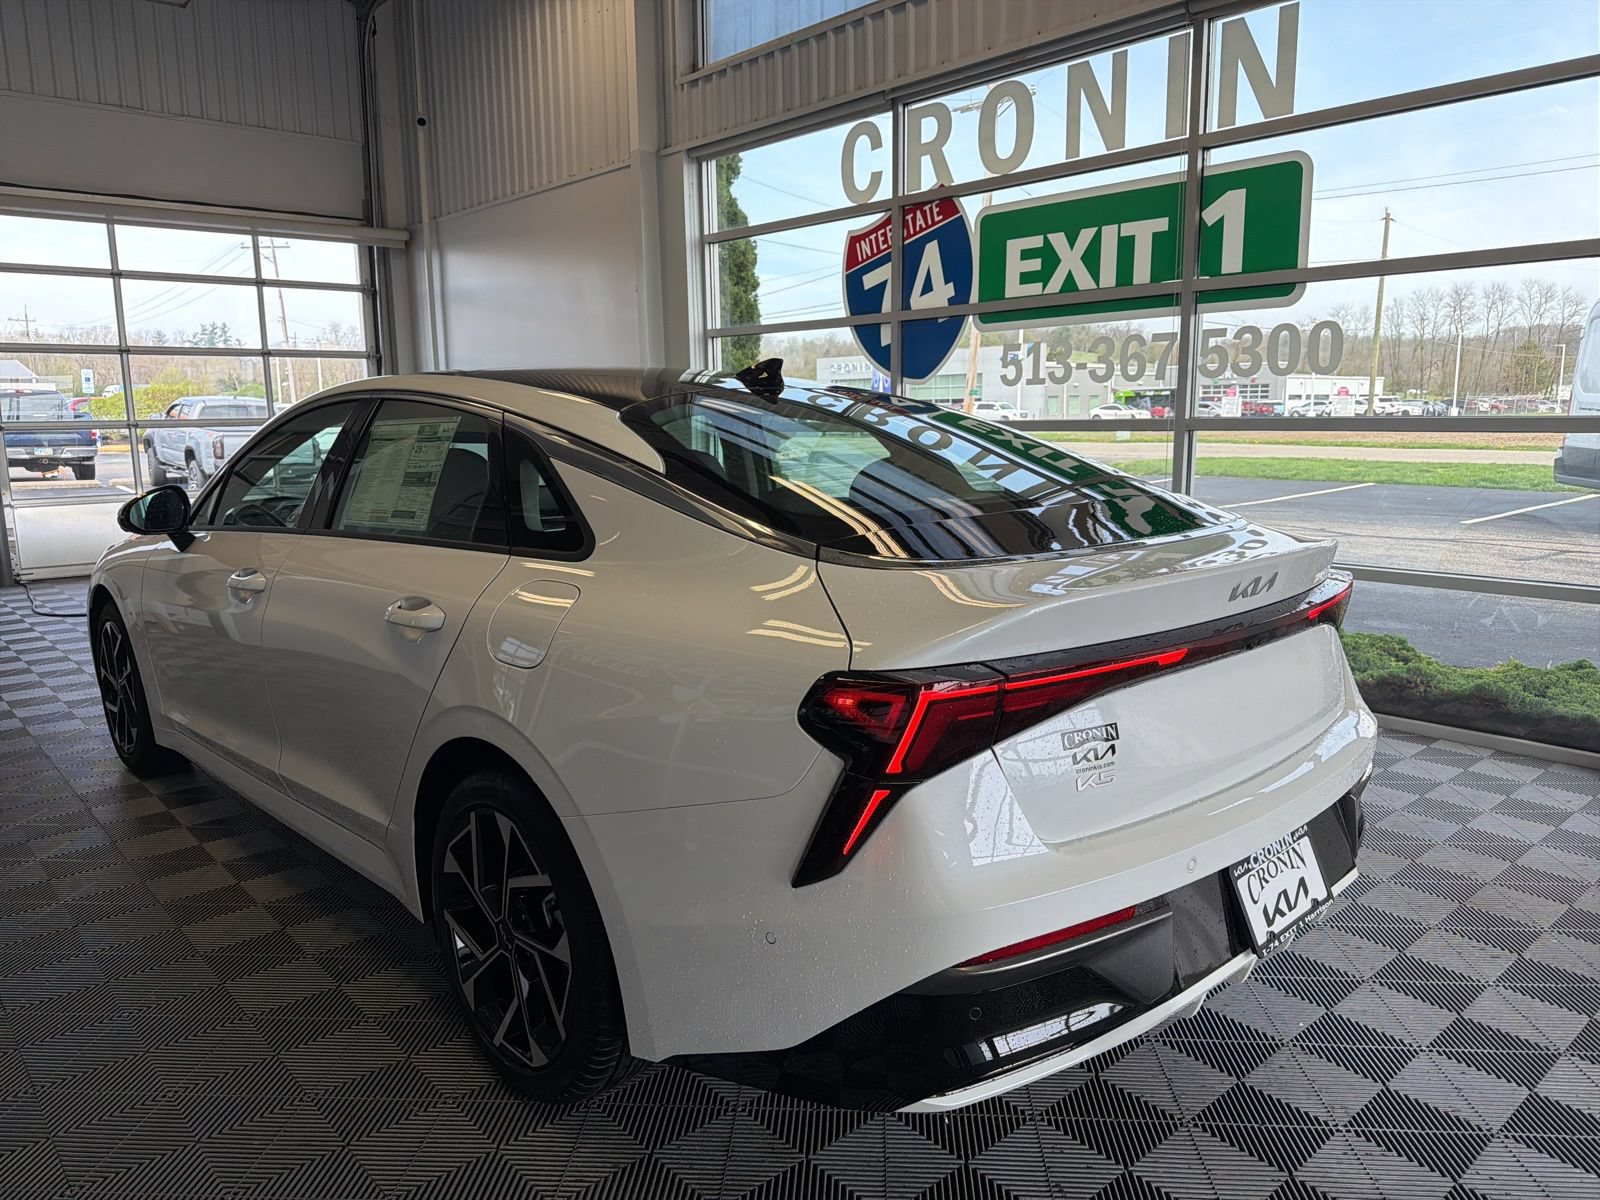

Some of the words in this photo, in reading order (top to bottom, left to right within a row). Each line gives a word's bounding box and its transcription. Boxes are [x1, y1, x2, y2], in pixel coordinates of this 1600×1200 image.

[840, 1, 1300, 204] CRONIN
[856, 200, 944, 263] INTETATE
[1004, 217, 1169, 298] EXIT
[1201, 188, 1247, 276] 1
[862, 239, 955, 347] 74
[830, 363, 871, 374] CRONIN
[1000, 320, 1344, 387] 513-3675300
[1228, 572, 1279, 602] KIA
[1064, 724, 1118, 748] CRONIN
[1072, 743, 1116, 766] KIA
[1076, 761, 1116, 774] croninkia.com
[1076, 769, 1116, 792] K5
[1247, 842, 1308, 905] CRONIN
[1250, 832, 1294, 869] CRONIN
[1262, 940, 1279, 957] I-74
[1280, 925, 1297, 943] EXIT
[1305, 898, 1334, 922] Harrison
[1263, 876, 1309, 929] KIA
